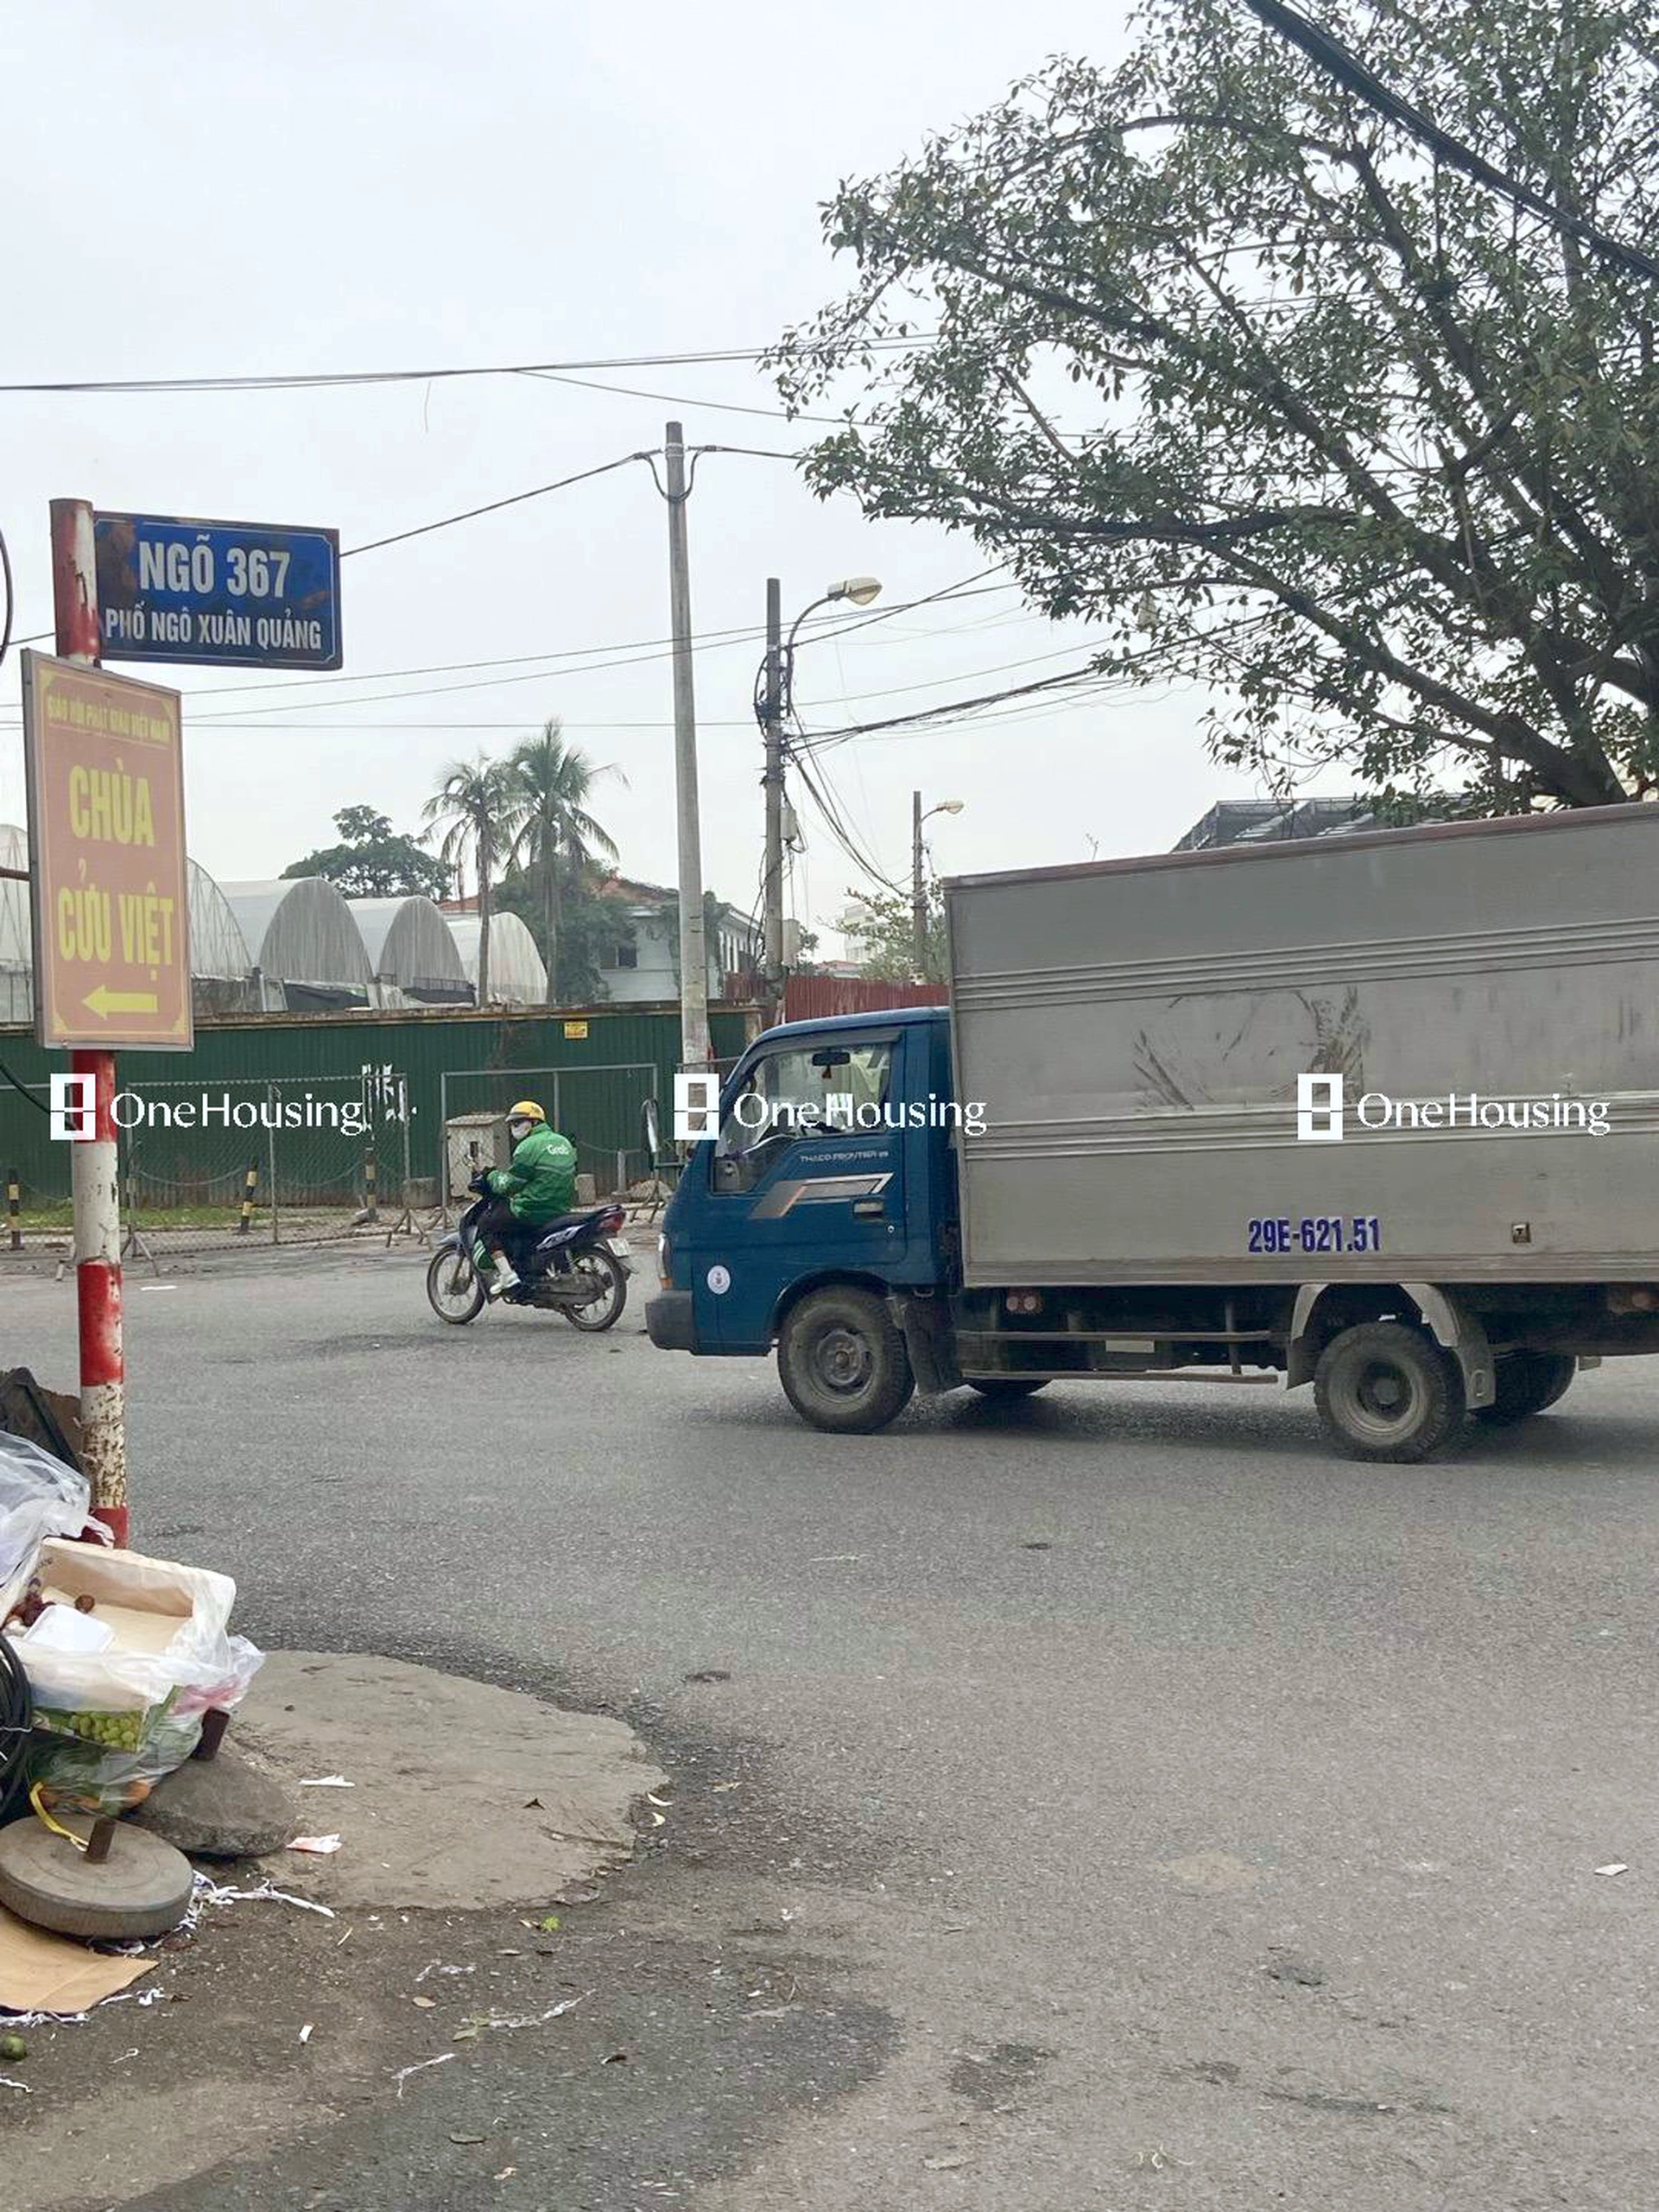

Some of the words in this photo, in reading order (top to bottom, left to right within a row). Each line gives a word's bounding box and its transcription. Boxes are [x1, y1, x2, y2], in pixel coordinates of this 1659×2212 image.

[138, 534, 214, 593] NGÕ
[226, 548, 291, 598] 367
[104, 601, 146, 640] PHỐ
[151, 606, 192, 643] NGÔ
[197, 609, 251, 647] XUÂN
[257, 607, 323, 650] QUẢNG
[68, 757, 155, 847] CHÙA
[58, 858, 112, 963] CỬU
[118, 881, 174, 981] VIỆT
[1248, 1218, 1380, 1252] 29E-621.51
